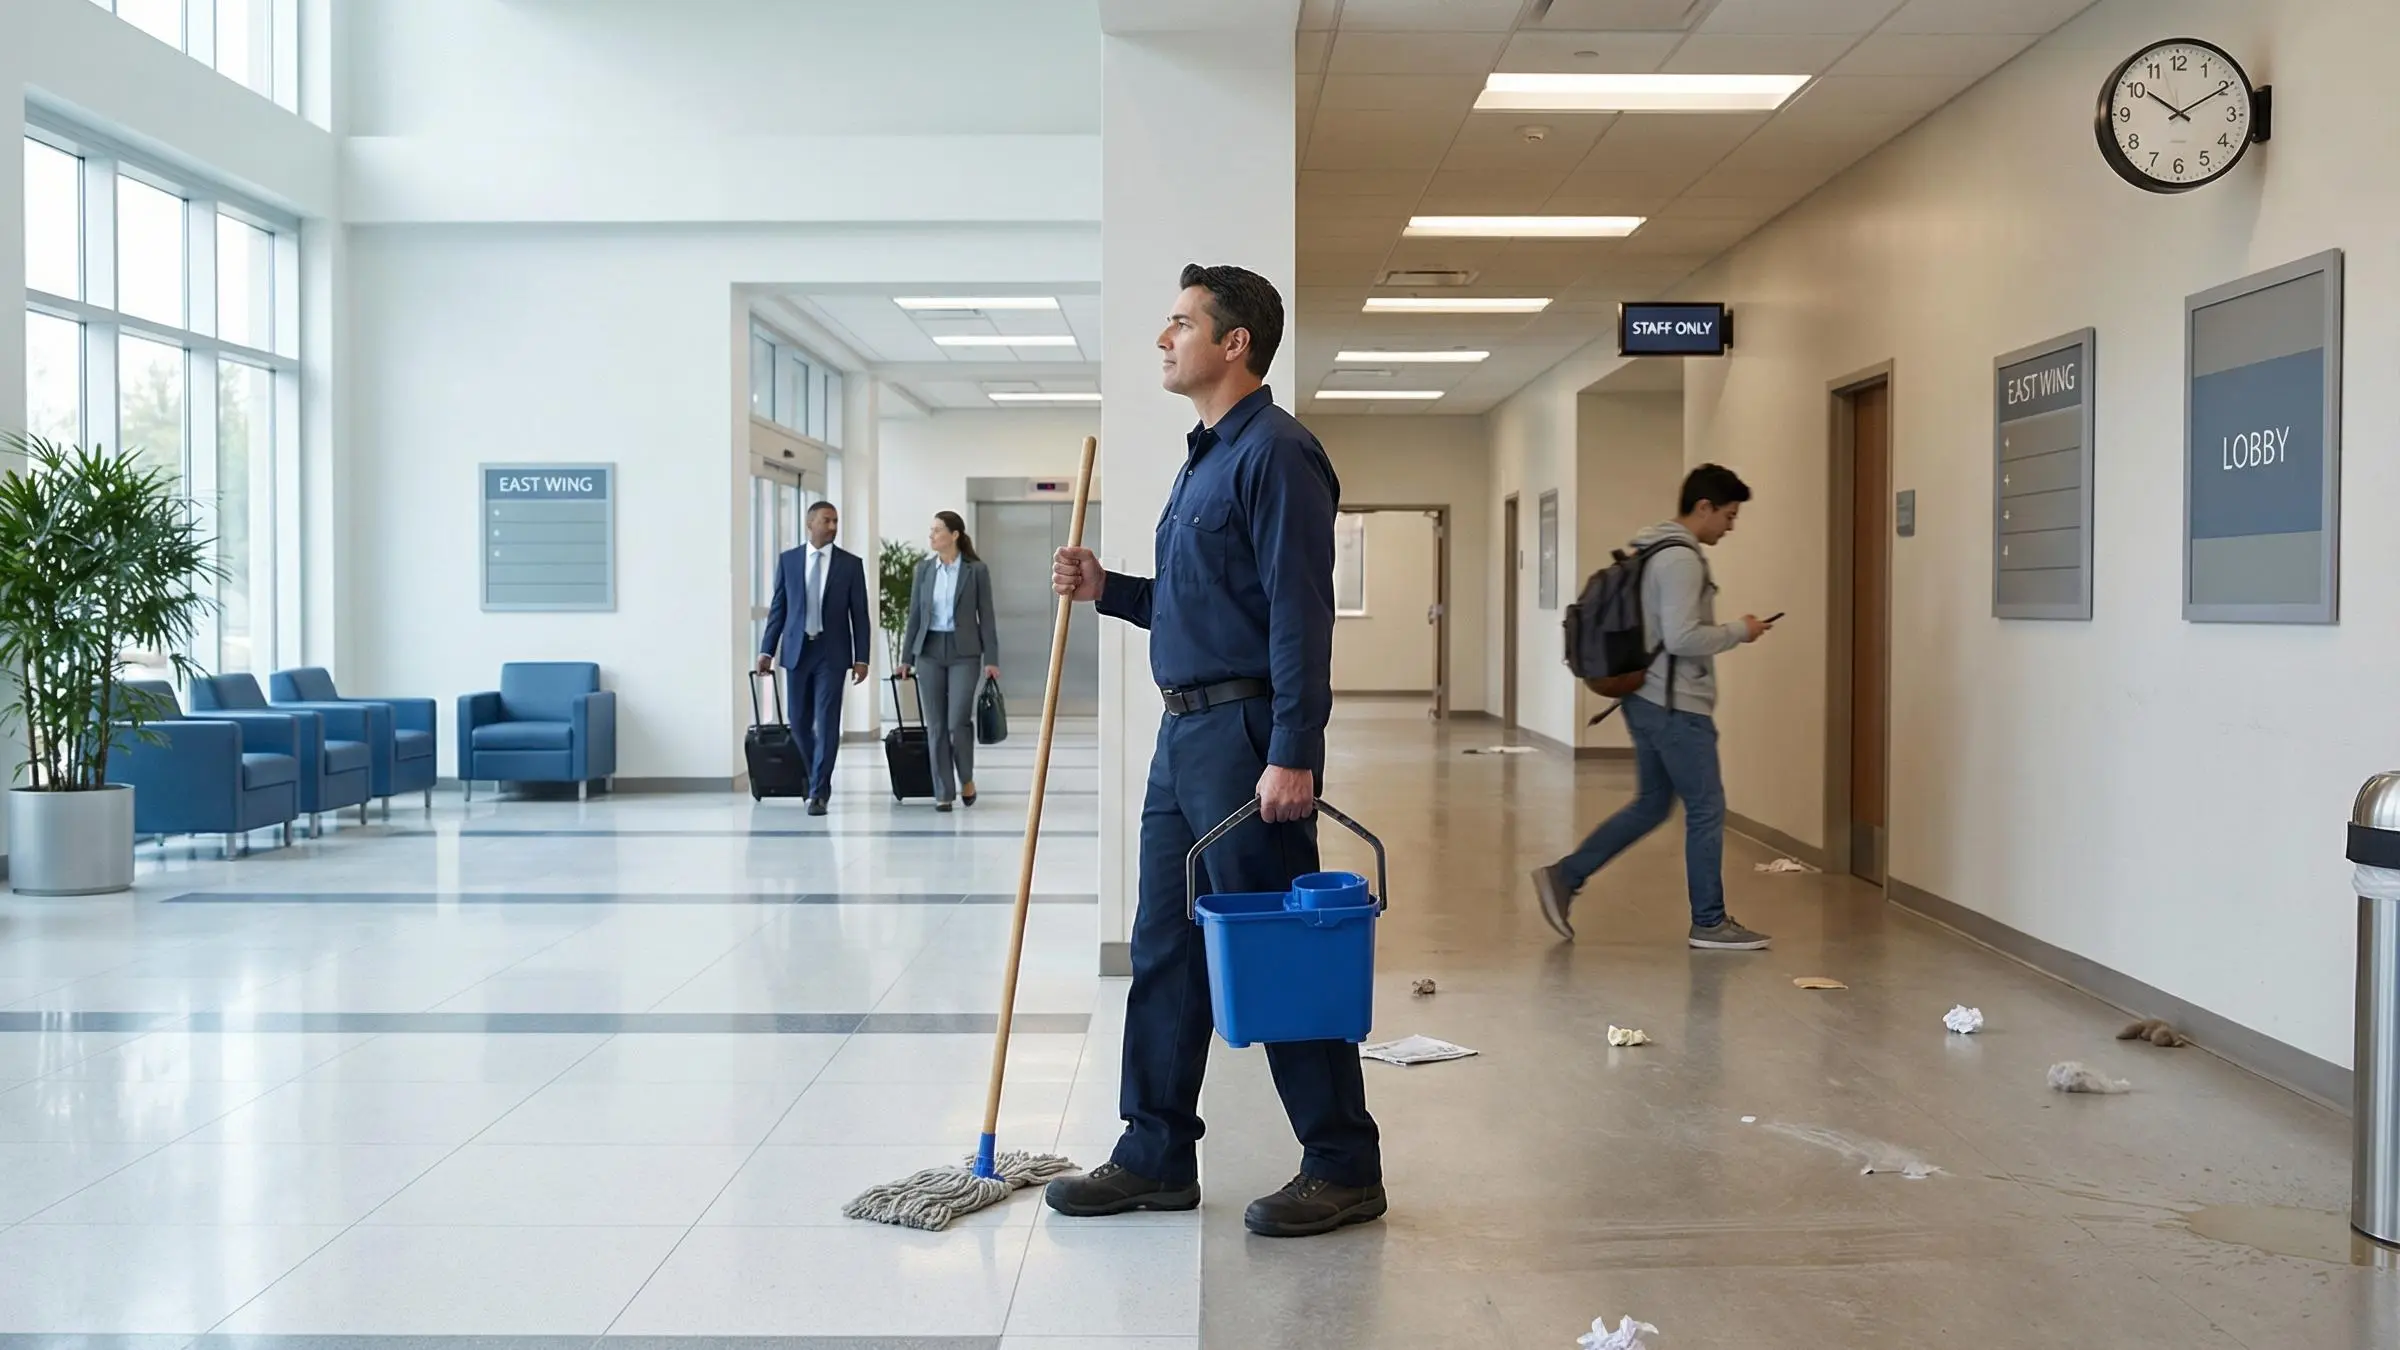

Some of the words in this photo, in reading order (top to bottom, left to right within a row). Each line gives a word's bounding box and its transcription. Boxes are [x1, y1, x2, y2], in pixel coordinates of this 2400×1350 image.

[2147, 63, 2160, 79] 11
[2169, 55, 2187, 71] 12
[2200, 62, 2208, 78] 1
[2127, 82, 2145, 98] 10
[2218, 80, 2229, 96] 2
[2120, 107, 2130, 122] 9
[2226, 106, 2236, 122] 3
[2128, 133, 2139, 149] 8
[2217, 132, 2229, 147] 4
[2149, 151, 2159, 167] 7
[2173, 158, 2184, 174] 6
[2199, 150, 2210, 166] 5
[1632, 321, 1672, 335] STAFF
[1675, 321, 1713, 335] ONLY
[2008, 373, 2038, 405] EAST
[2039, 363, 2075, 396] WING
[2222, 425, 2290, 470] LOBBY
[499, 476, 541, 492] EAST
[544, 476, 593, 492] WING
